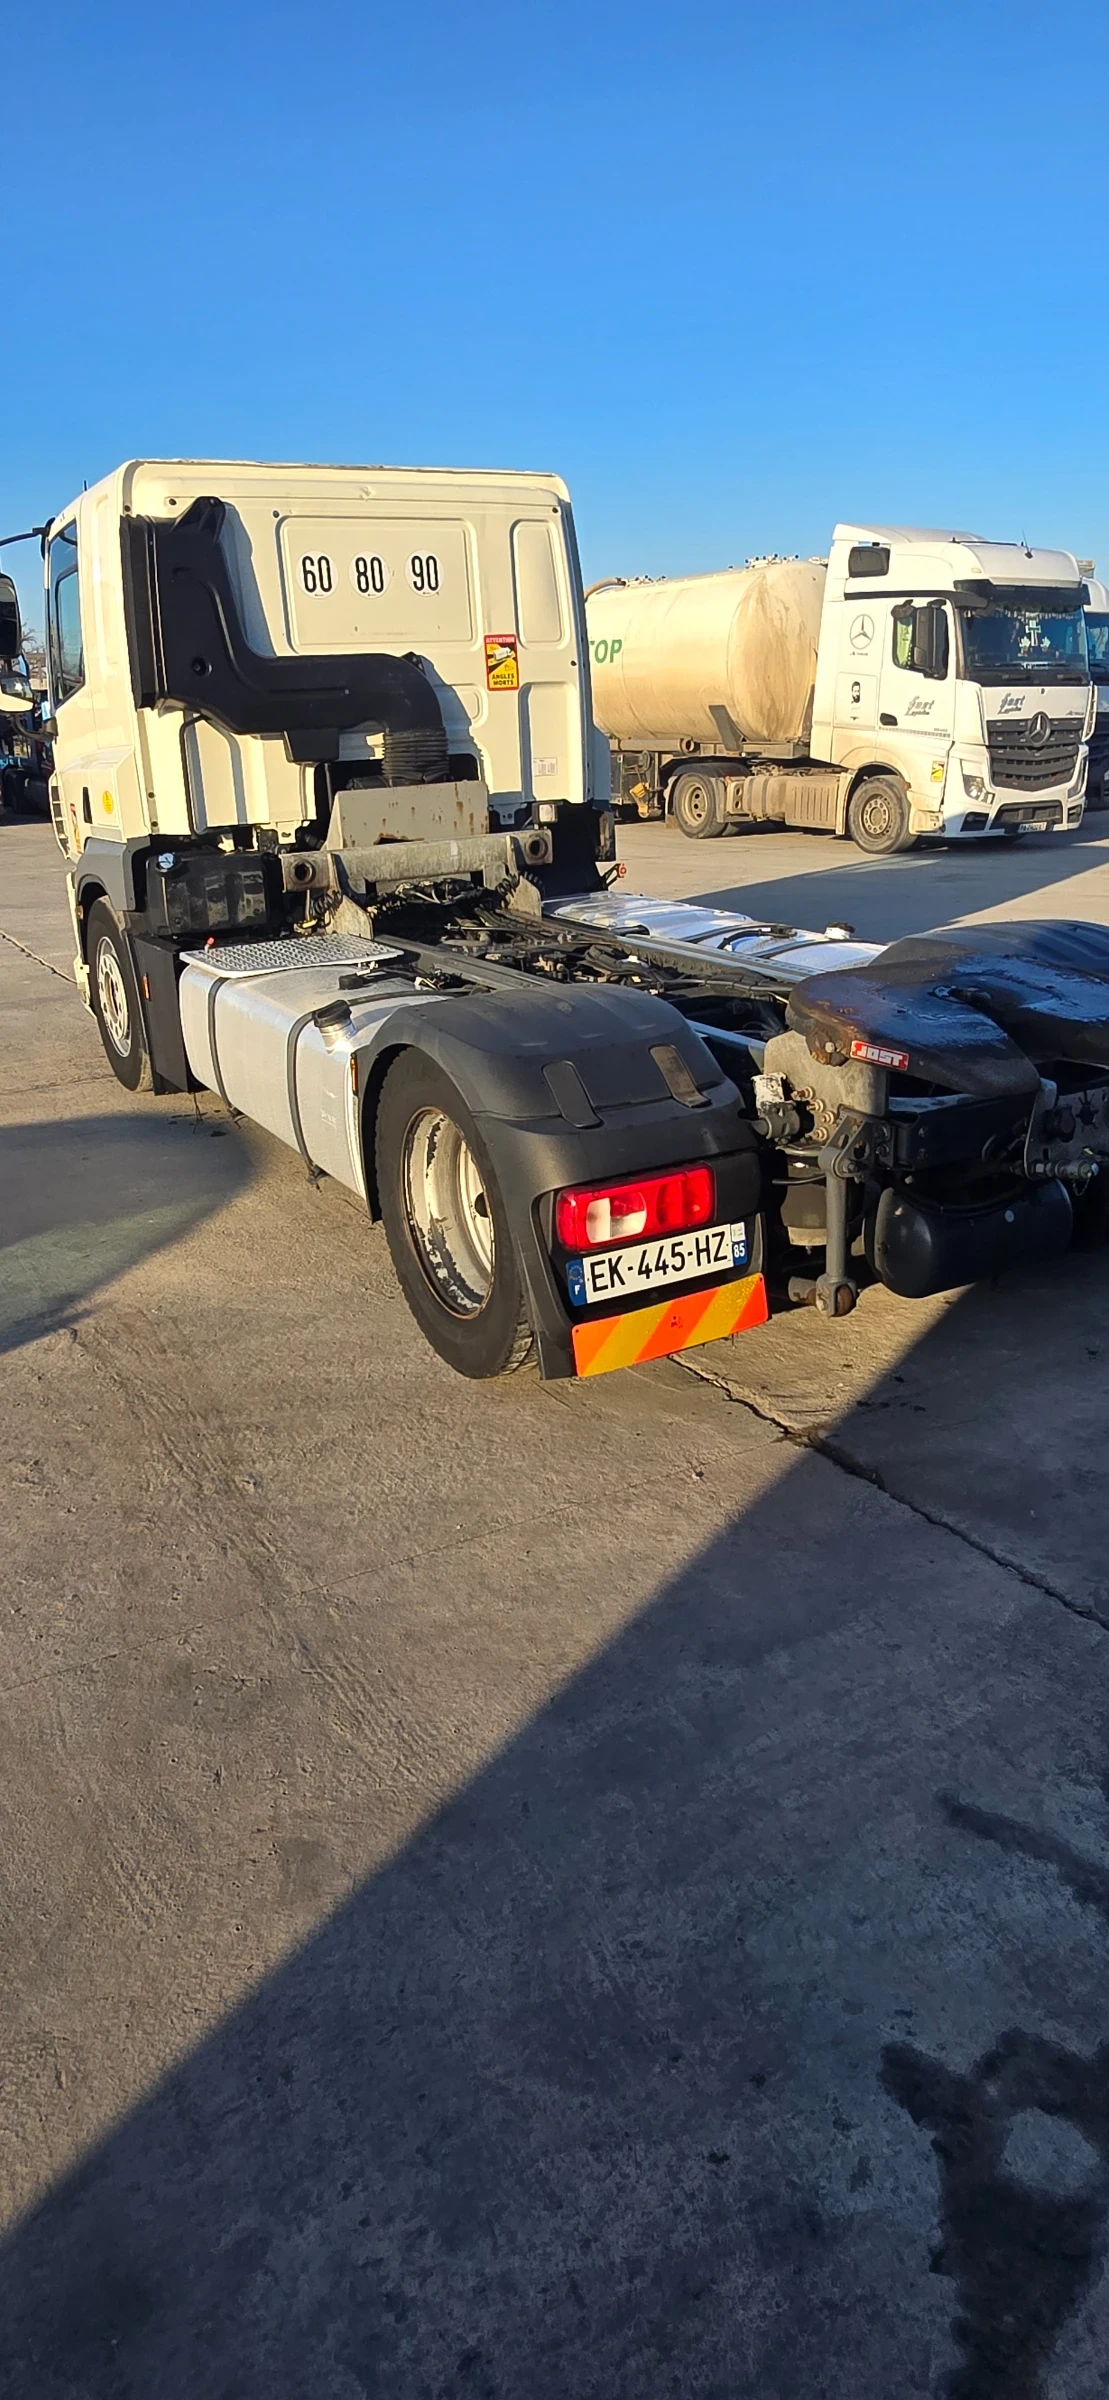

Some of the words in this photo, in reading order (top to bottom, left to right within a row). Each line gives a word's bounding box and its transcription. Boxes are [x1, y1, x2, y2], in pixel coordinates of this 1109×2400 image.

[302, 555, 332, 593] 60
[355, 556, 384, 593] 80
[411, 555, 439, 591] 90
[589, 639, 622, 663] OP
[856, 1045, 903, 1066] JOST
[733, 1242, 745, 1258] 85
[590, 1231, 728, 1293] EK-445-HZ
[574, 1284, 581, 1296] F
